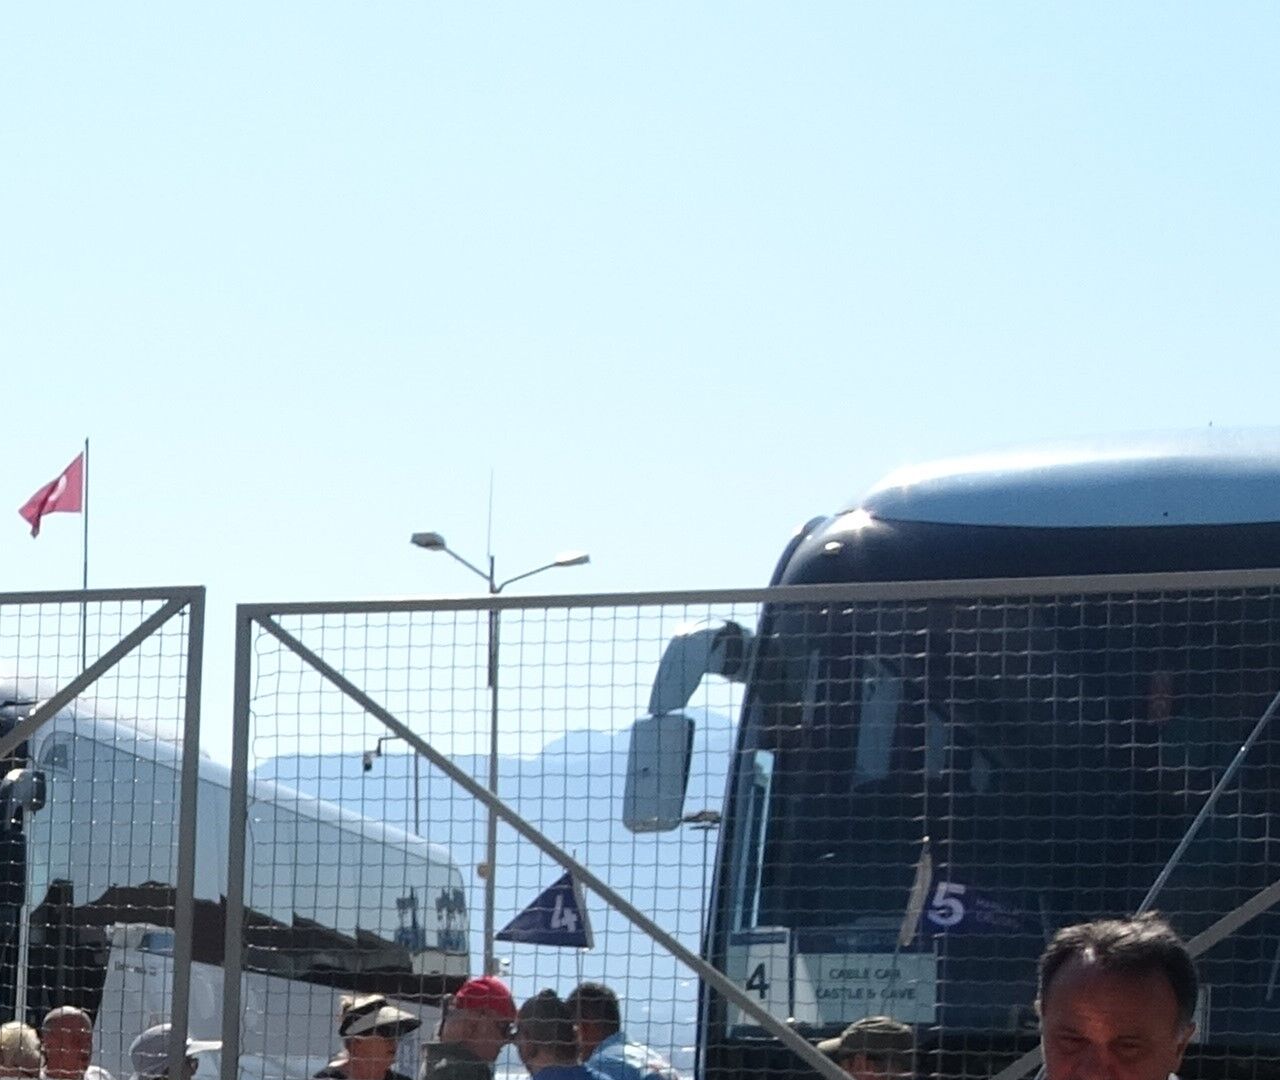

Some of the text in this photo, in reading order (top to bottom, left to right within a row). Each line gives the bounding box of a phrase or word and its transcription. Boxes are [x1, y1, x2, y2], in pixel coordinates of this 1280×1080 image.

[550, 894, 579, 933] 4
[927, 881, 967, 926] 5
[745, 962, 770, 999] 4
[828, 968, 870, 980] CABLE
[816, 987, 864, 1000] CASTLE
